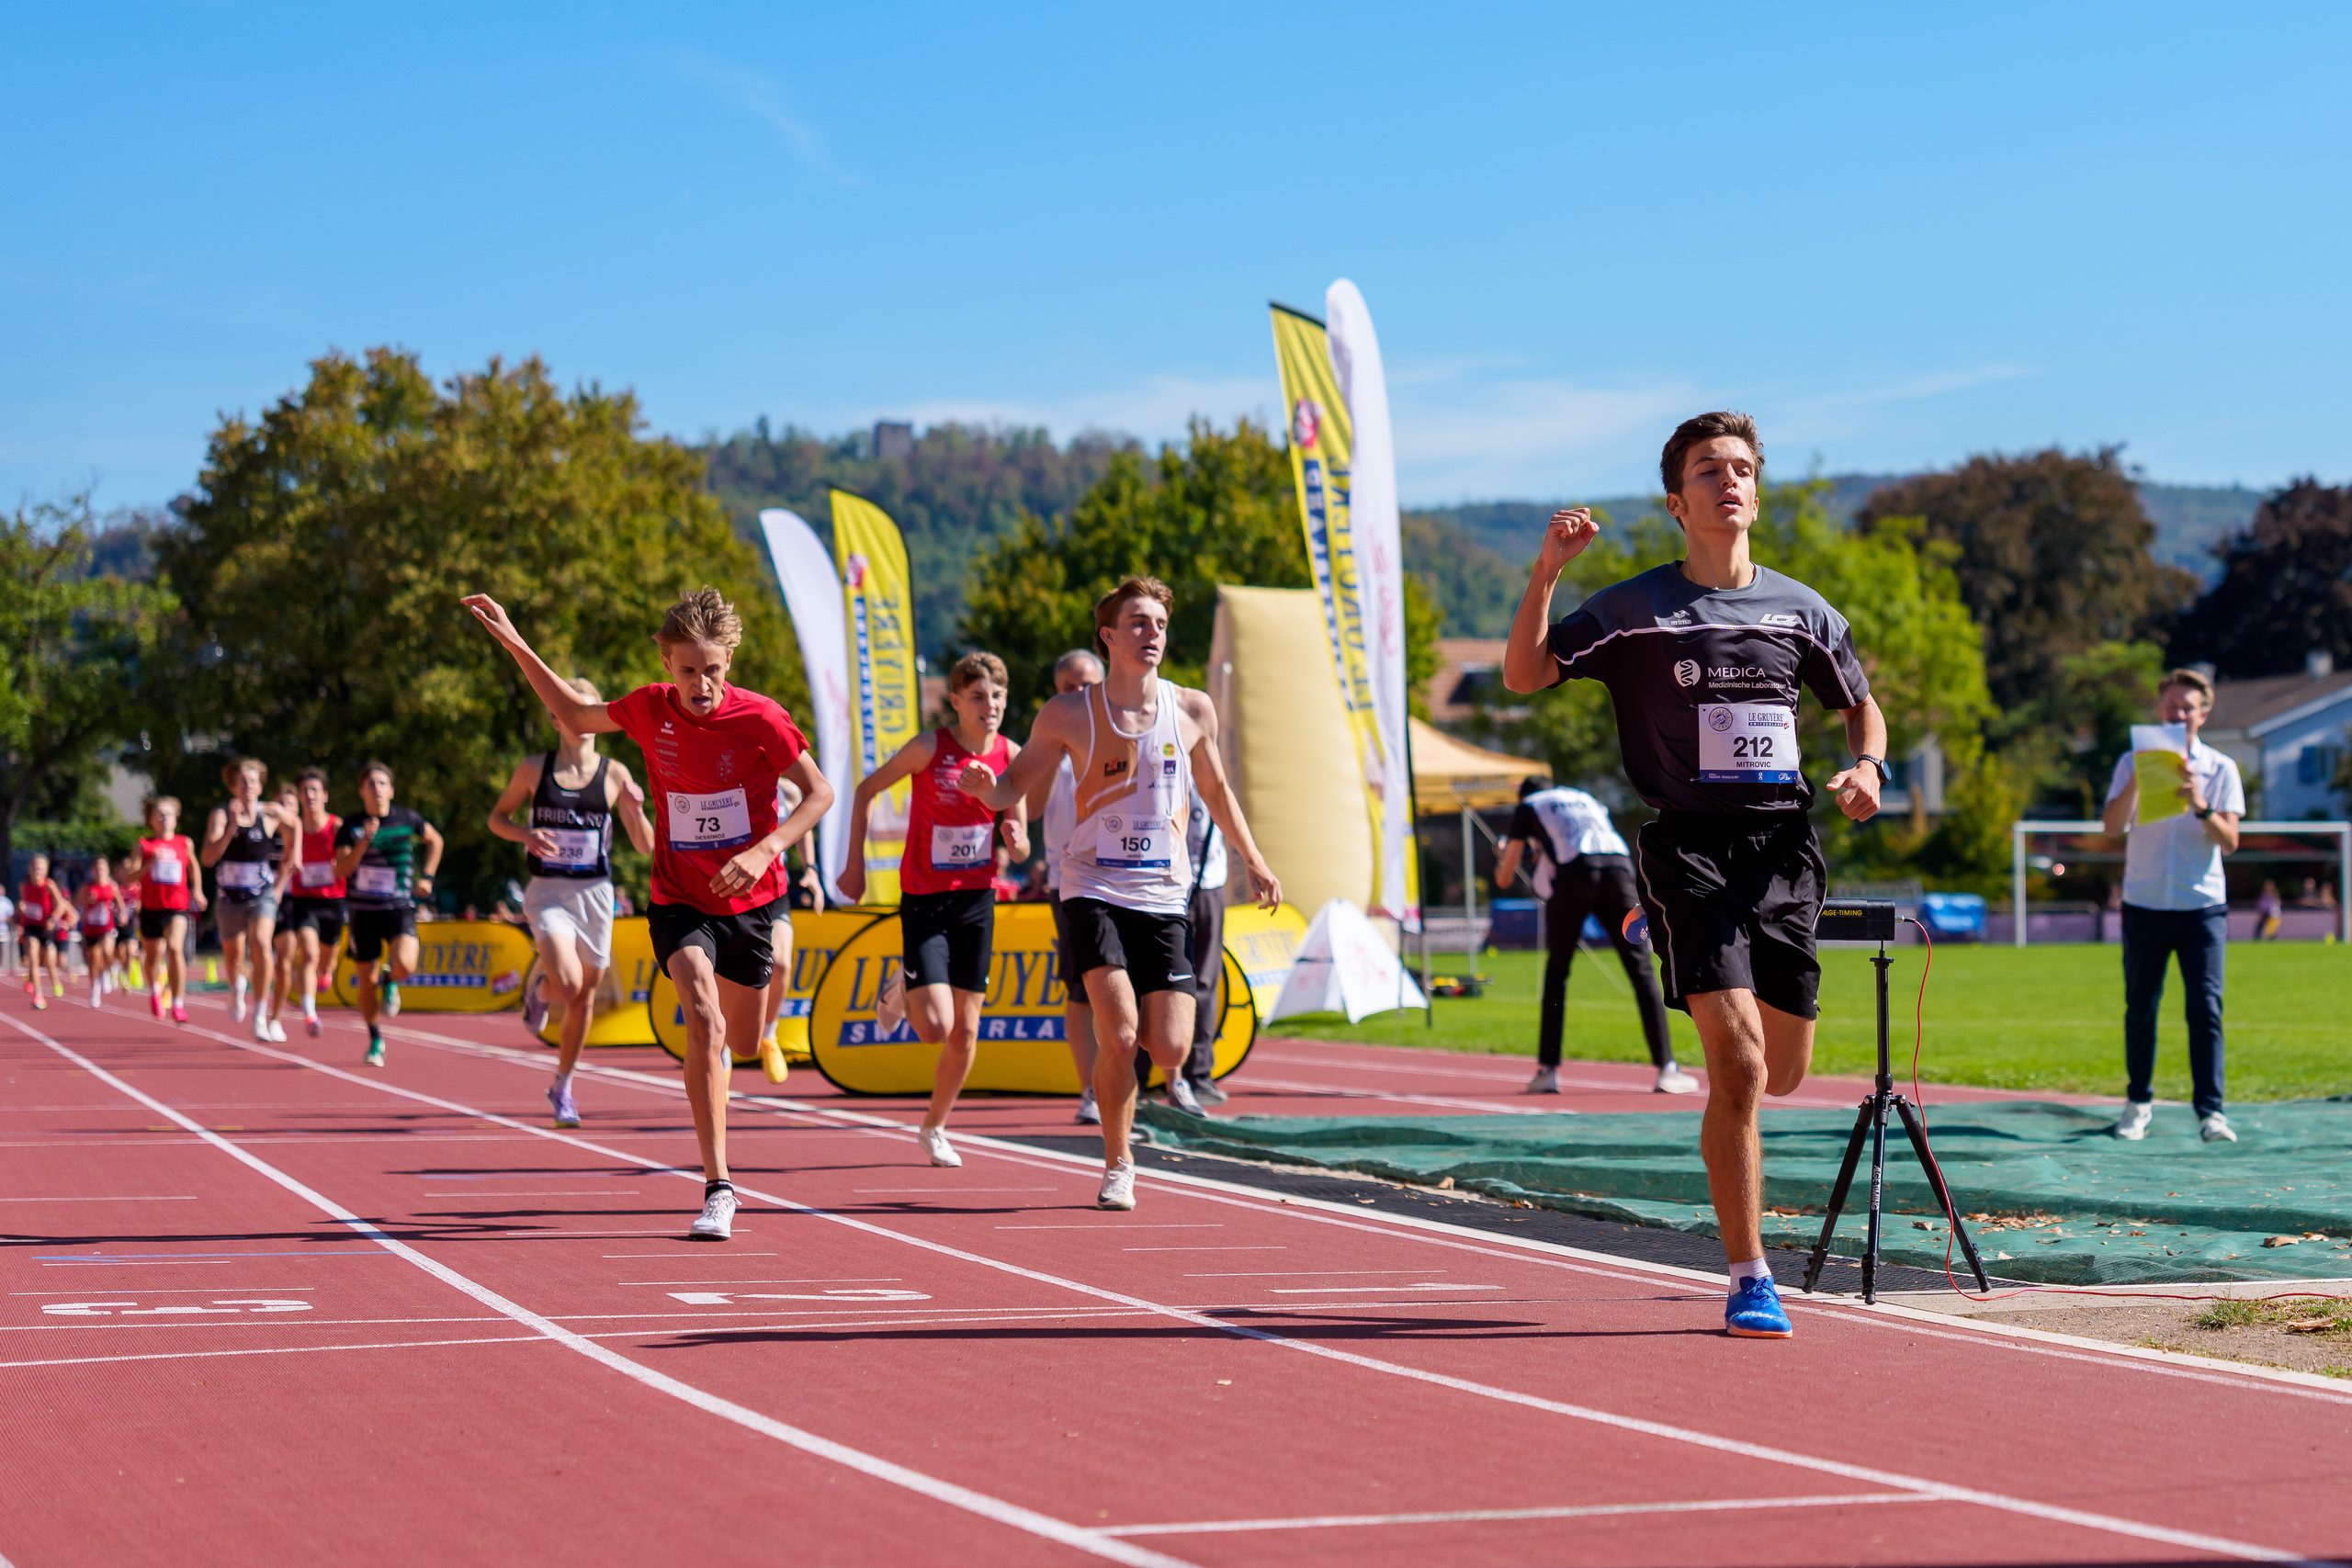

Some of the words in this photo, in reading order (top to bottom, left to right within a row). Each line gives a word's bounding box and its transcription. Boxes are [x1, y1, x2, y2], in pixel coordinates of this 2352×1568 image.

[1708, 667, 1766, 678] MEDICA
[1748, 713, 1757, 721] LE
[1733, 736, 1773, 758] 212
[695, 818, 720, 833] 73
[951, 844, 977, 857] 201
[1121, 837, 1151, 852] 150
